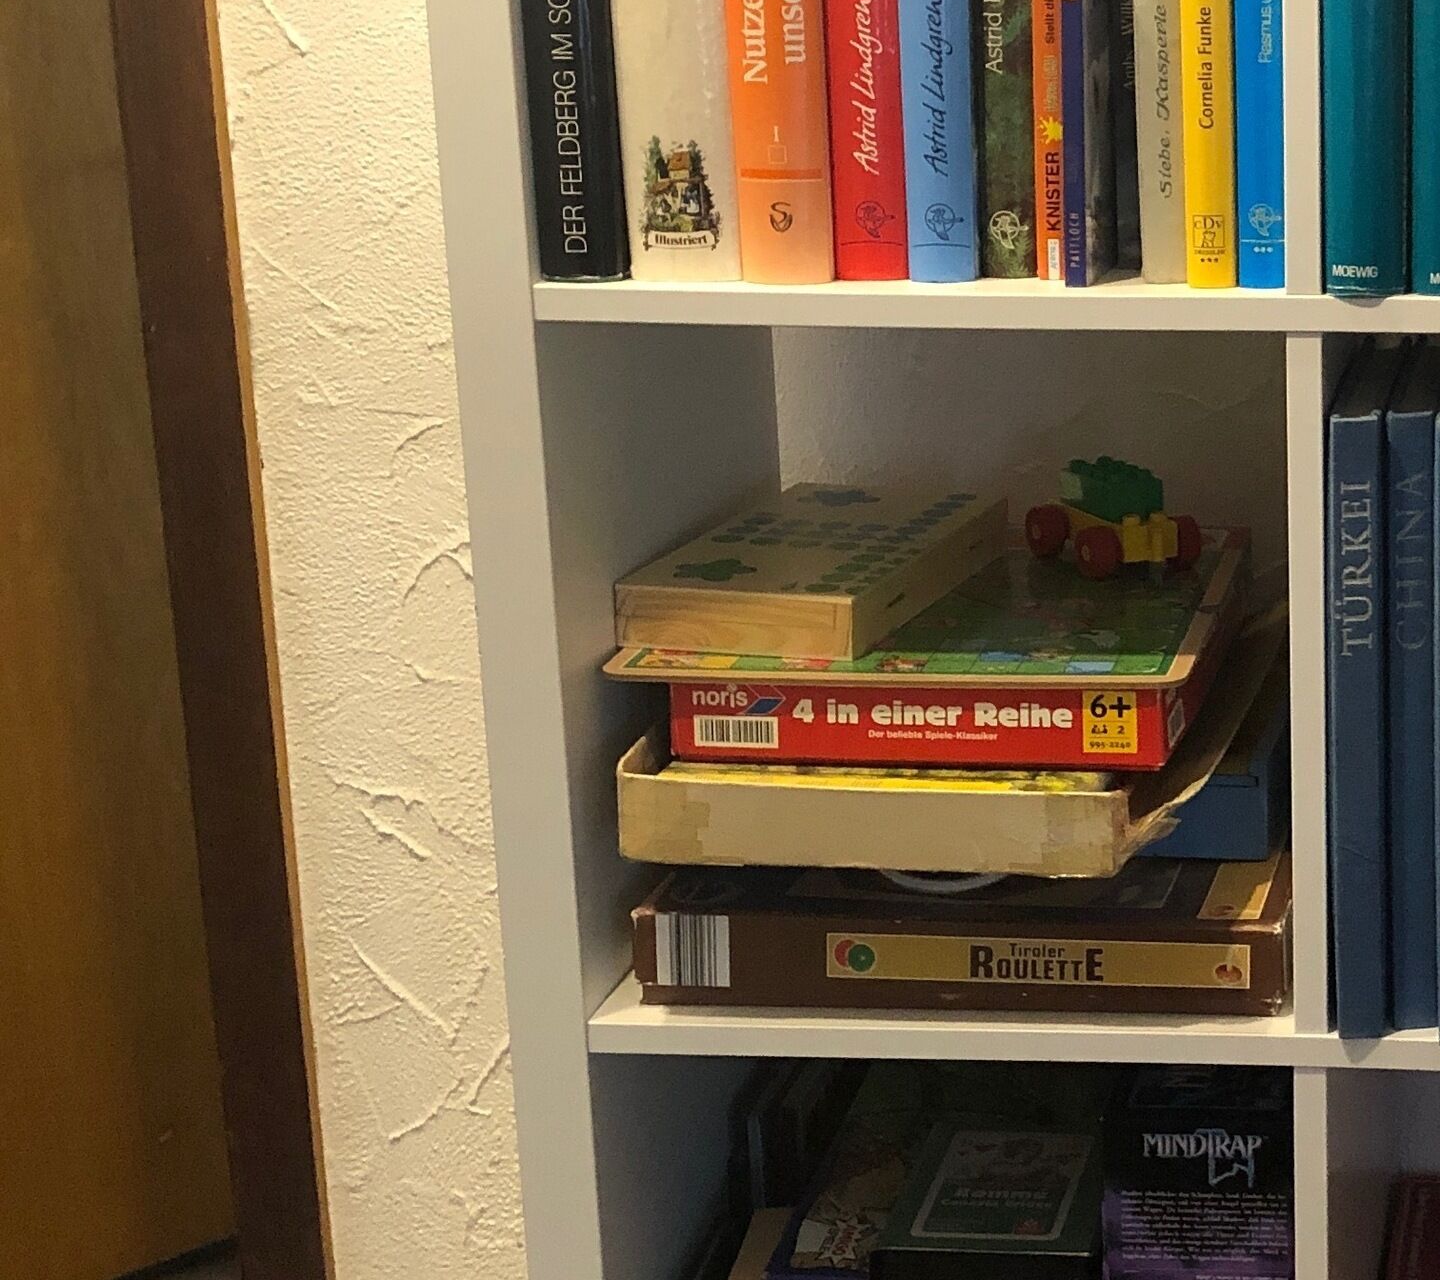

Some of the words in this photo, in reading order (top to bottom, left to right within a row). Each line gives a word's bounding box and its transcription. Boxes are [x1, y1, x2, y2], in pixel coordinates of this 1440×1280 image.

[550, 32, 574, 61] IM
[984, 9, 1003, 74] Astrid
[1196, 6, 1213, 56] Funke
[1258, 6, 1273, 64] Rasmus
[1152, 4, 1172, 122] Kasperle
[1197, 60, 1214, 130] Cornelia
[552, 69, 584, 196] FELDBERG
[851, 100, 881, 176] Astrid
[922, 102, 949, 178] Astrid
[1045, 151, 1061, 232] KNISTER
[562, 203, 588, 254] DER
[654, 233, 708, 247] Illustriert
[1332, 264, 1379, 278] MOEWIG
[1334, 480, 1374, 658] TÜRKEI
[1394, 471, 1428, 651] CHINA
[692, 683, 748, 708] noris
[792, 698, 815, 723] 4
[826, 698, 859, 725] in
[871, 699, 952, 727] einer
[973, 701, 1073, 728] Reihe
[1089, 694, 1131, 720] 6+
[886, 729, 923, 740] beliebte
[925, 730, 998, 741] Spiele-Klassiker
[970, 944, 1104, 982] ROULETTE
[1010, 943, 1066, 959] Tiroler
[1142, 1128, 1263, 1169] MINDTRAP
